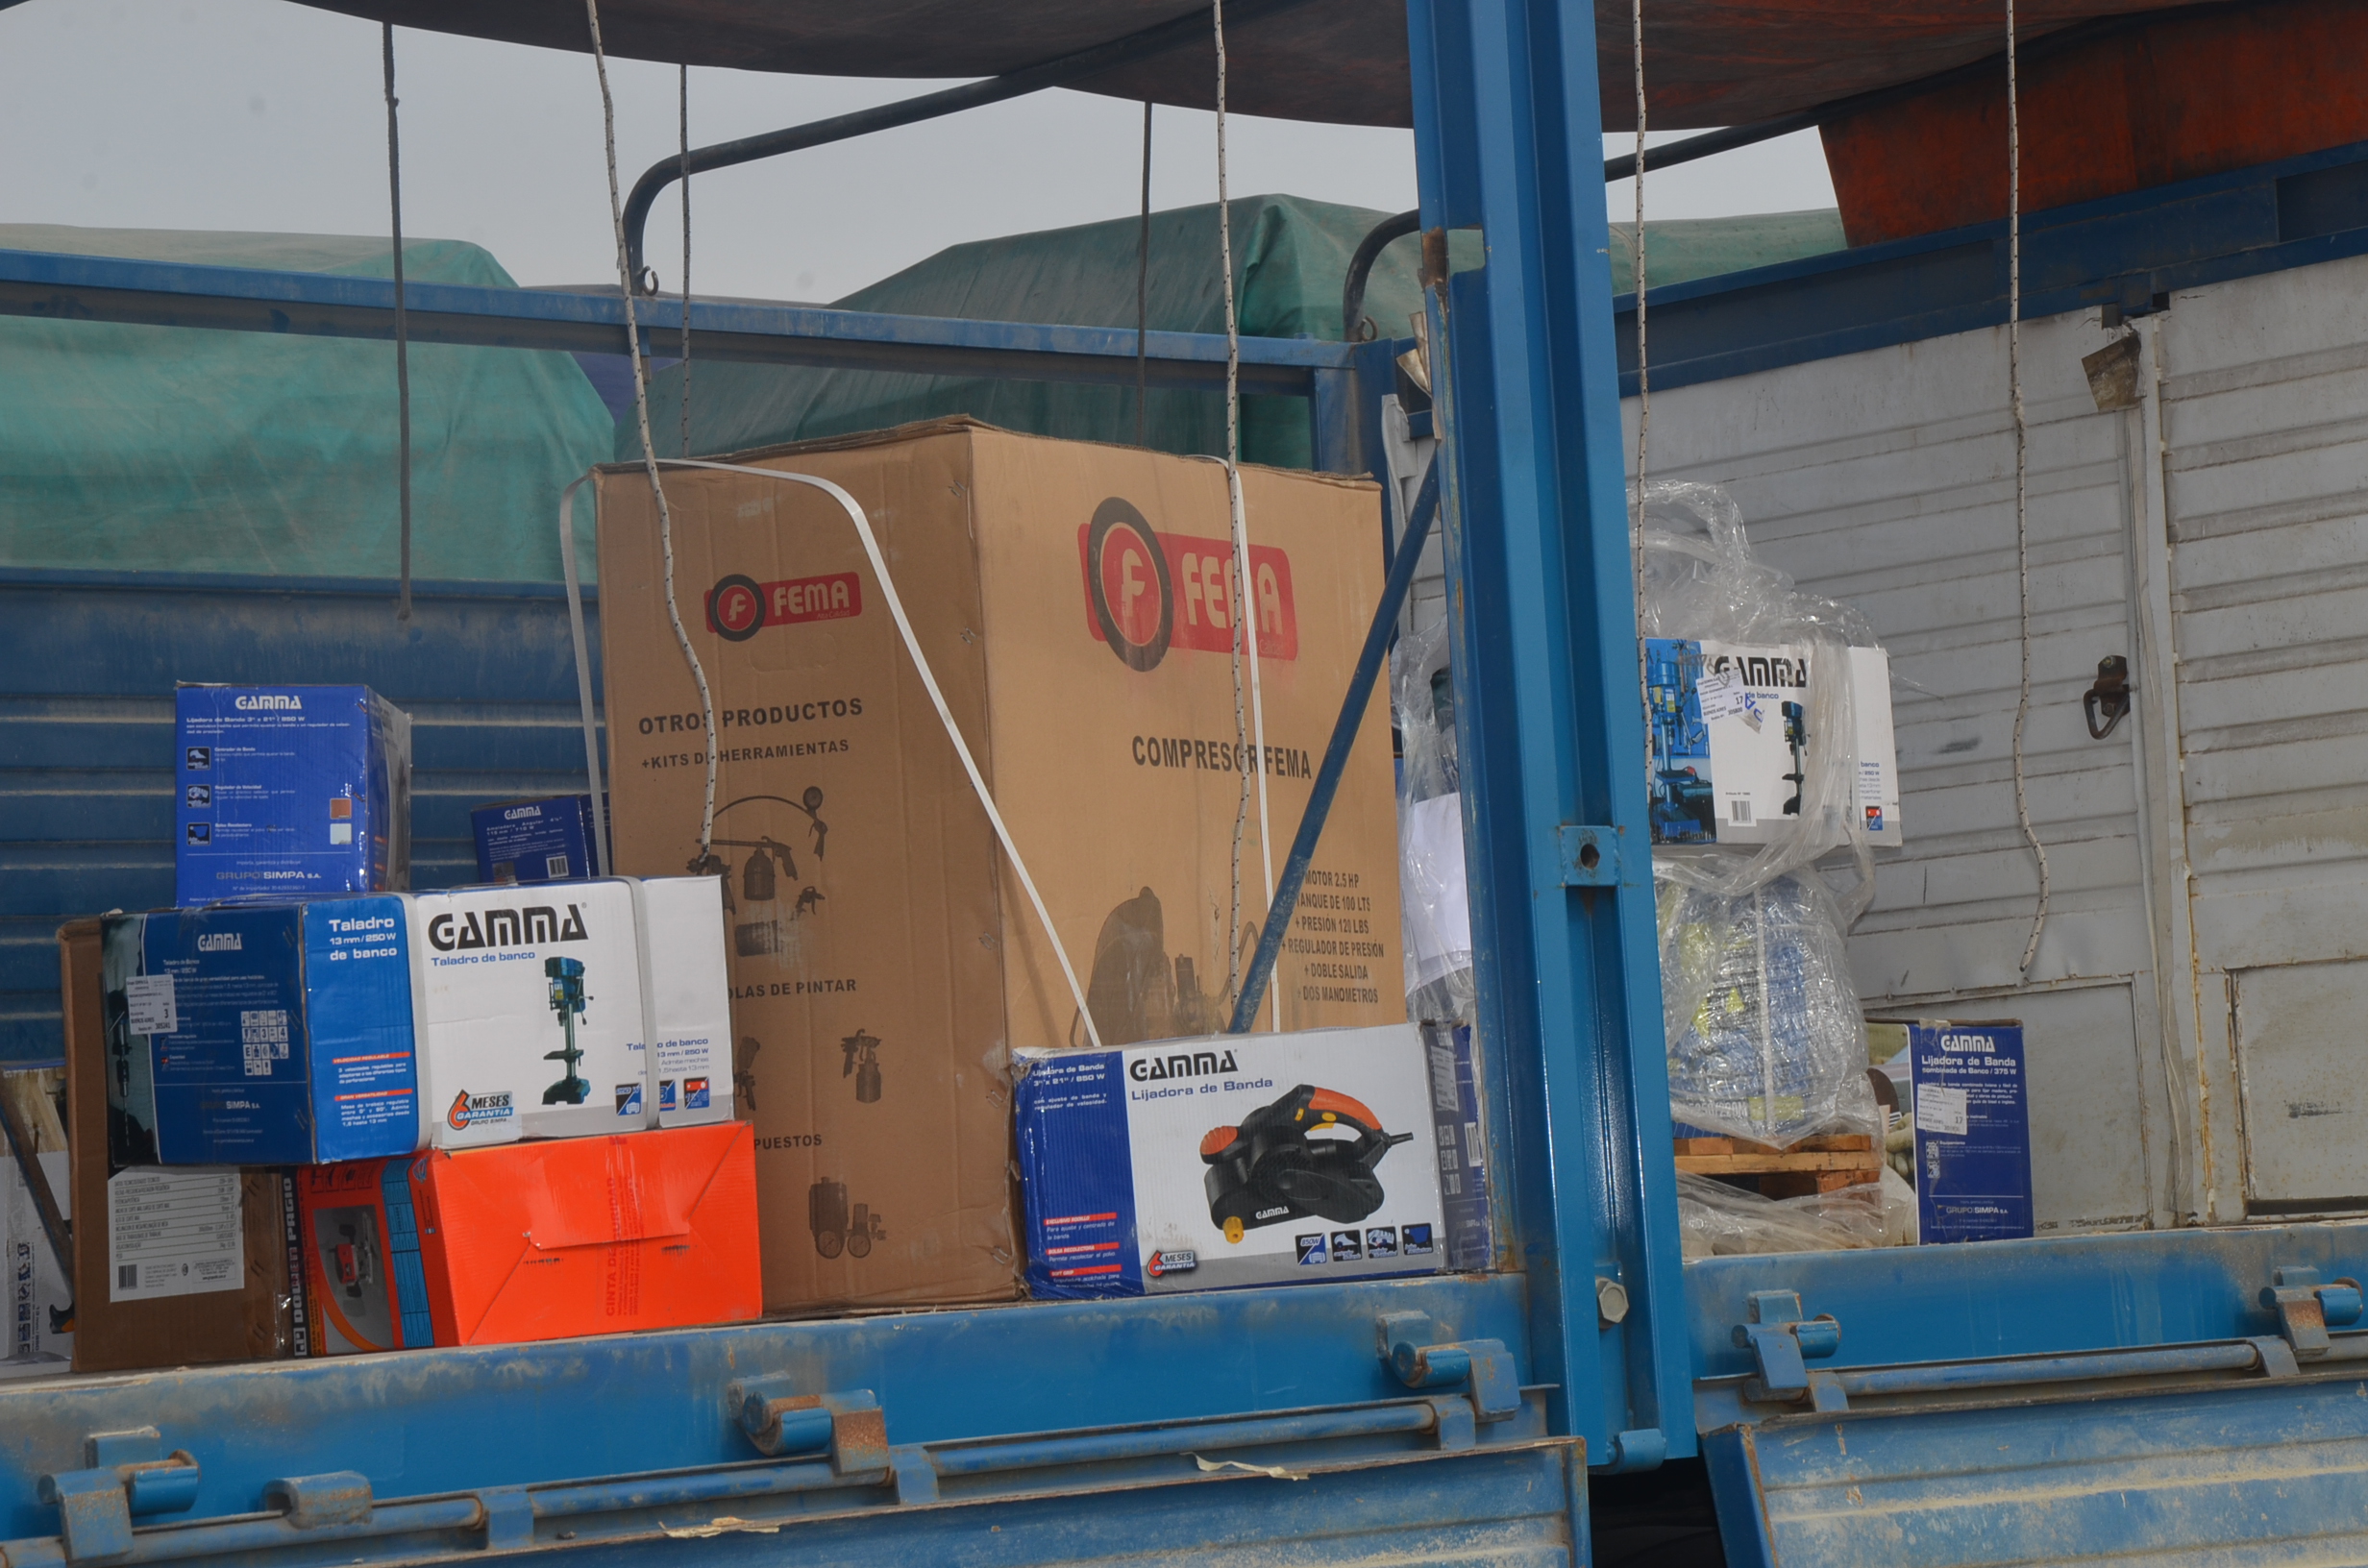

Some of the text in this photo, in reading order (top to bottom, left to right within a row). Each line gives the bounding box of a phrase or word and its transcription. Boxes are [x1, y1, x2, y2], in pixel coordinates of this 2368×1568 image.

[728, 580, 850, 622] F FEMA
[235, 696, 302, 710] GAMMA
[1736, 696, 1742, 704] 17
[723, 698, 862, 727] PRODUCTOS
[720, 739, 849, 762] HERRAMIENTAS
[505, 805, 541, 820] GAMMA
[216, 871, 260, 880] GRUPO
[263, 870, 305, 879] SIMPA
[1305, 870, 1359, 888] MOTOR 2.5 HP
[1330, 895, 1340, 909] DE
[1343, 896, 1355, 911] 100
[1358, 897, 1370, 912] LTS
[329, 917, 394, 932] Taladro
[428, 904, 589, 952] GAMMA
[1302, 914, 1369, 934] PRESIÓN 120 LBS
[198, 933, 242, 951] GAMMA
[1289, 939, 1384, 958] REGULADOR DE PRESIÓN
[330, 948, 397, 961] de banco
[432, 950, 535, 967] Taladro de banco
[1311, 963, 1369, 979] DOBLE SALIDA
[771, 983, 790, 996] DE
[797, 979, 856, 993] PINTAR
[1303, 986, 1378, 1003] DOS MANOMETROS
[164, 1009, 169, 1018] 3
[627, 1042, 663, 1051] Talao
[1941, 1035, 1995, 1052] GAMMA
[1130, 1050, 1238, 1082] GAMMA
[1921, 1055, 2016, 1066] Lijadora de Banda
[1132, 1078, 1272, 1101] Lijadora de Banda
[226, 1101, 251, 1110] SIMPA
[471, 1094, 509, 1110] MESES
[456, 1109, 510, 1119] GARANTIA
[1256, 1206, 1290, 1219] GAMMA
[284, 1177, 304, 1323] DOWEN PAGIO
[1165, 1253, 1192, 1262] MESES
[1155, 1262, 1196, 1271] GARANTIA
[606, 1247, 616, 1316] CINTA DE
